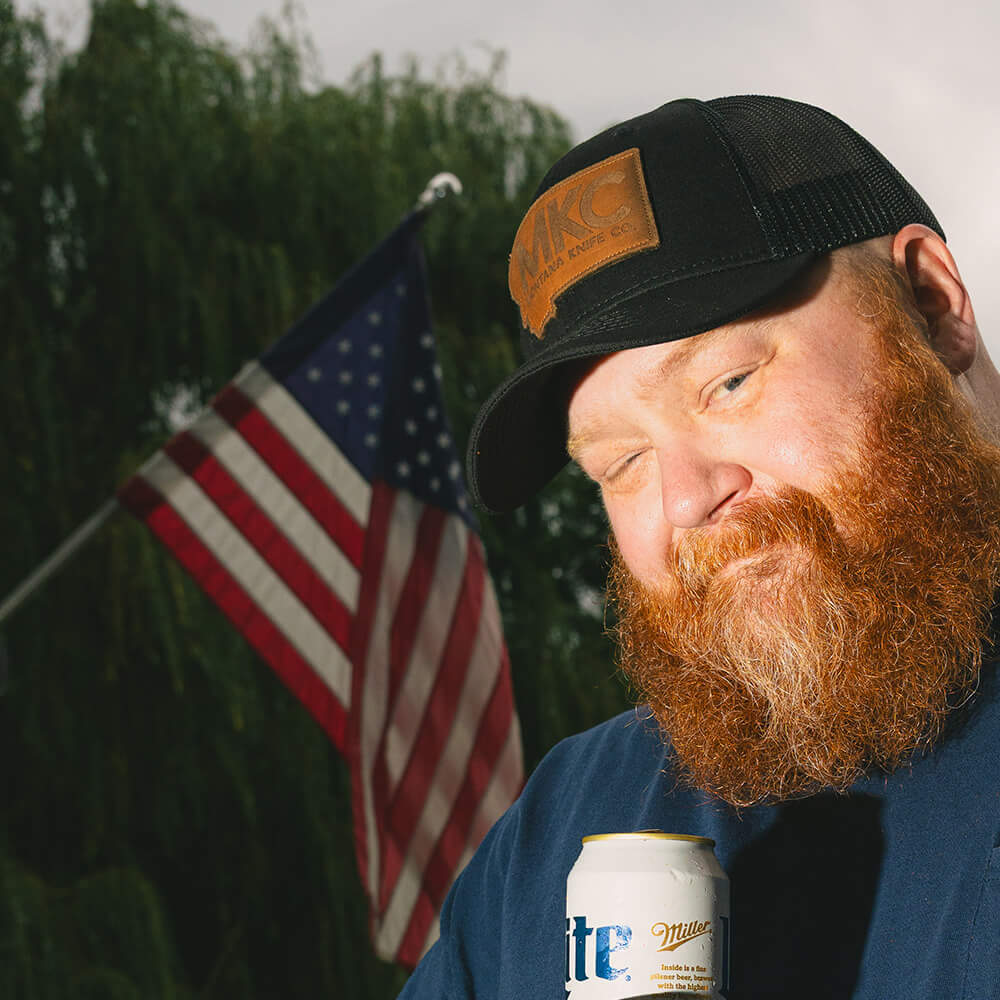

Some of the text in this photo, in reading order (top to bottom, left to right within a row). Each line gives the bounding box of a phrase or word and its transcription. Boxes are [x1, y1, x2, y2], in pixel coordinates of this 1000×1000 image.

[517, 170, 632, 301] MKC
[567, 232, 606, 260] KNIFE
[610, 222, 637, 238] CO.
[651, 920, 712, 950] Miller
[661, 963, 683, 971] Inside
[684, 964, 690, 972] is
[676, 973, 693, 981] beer,
